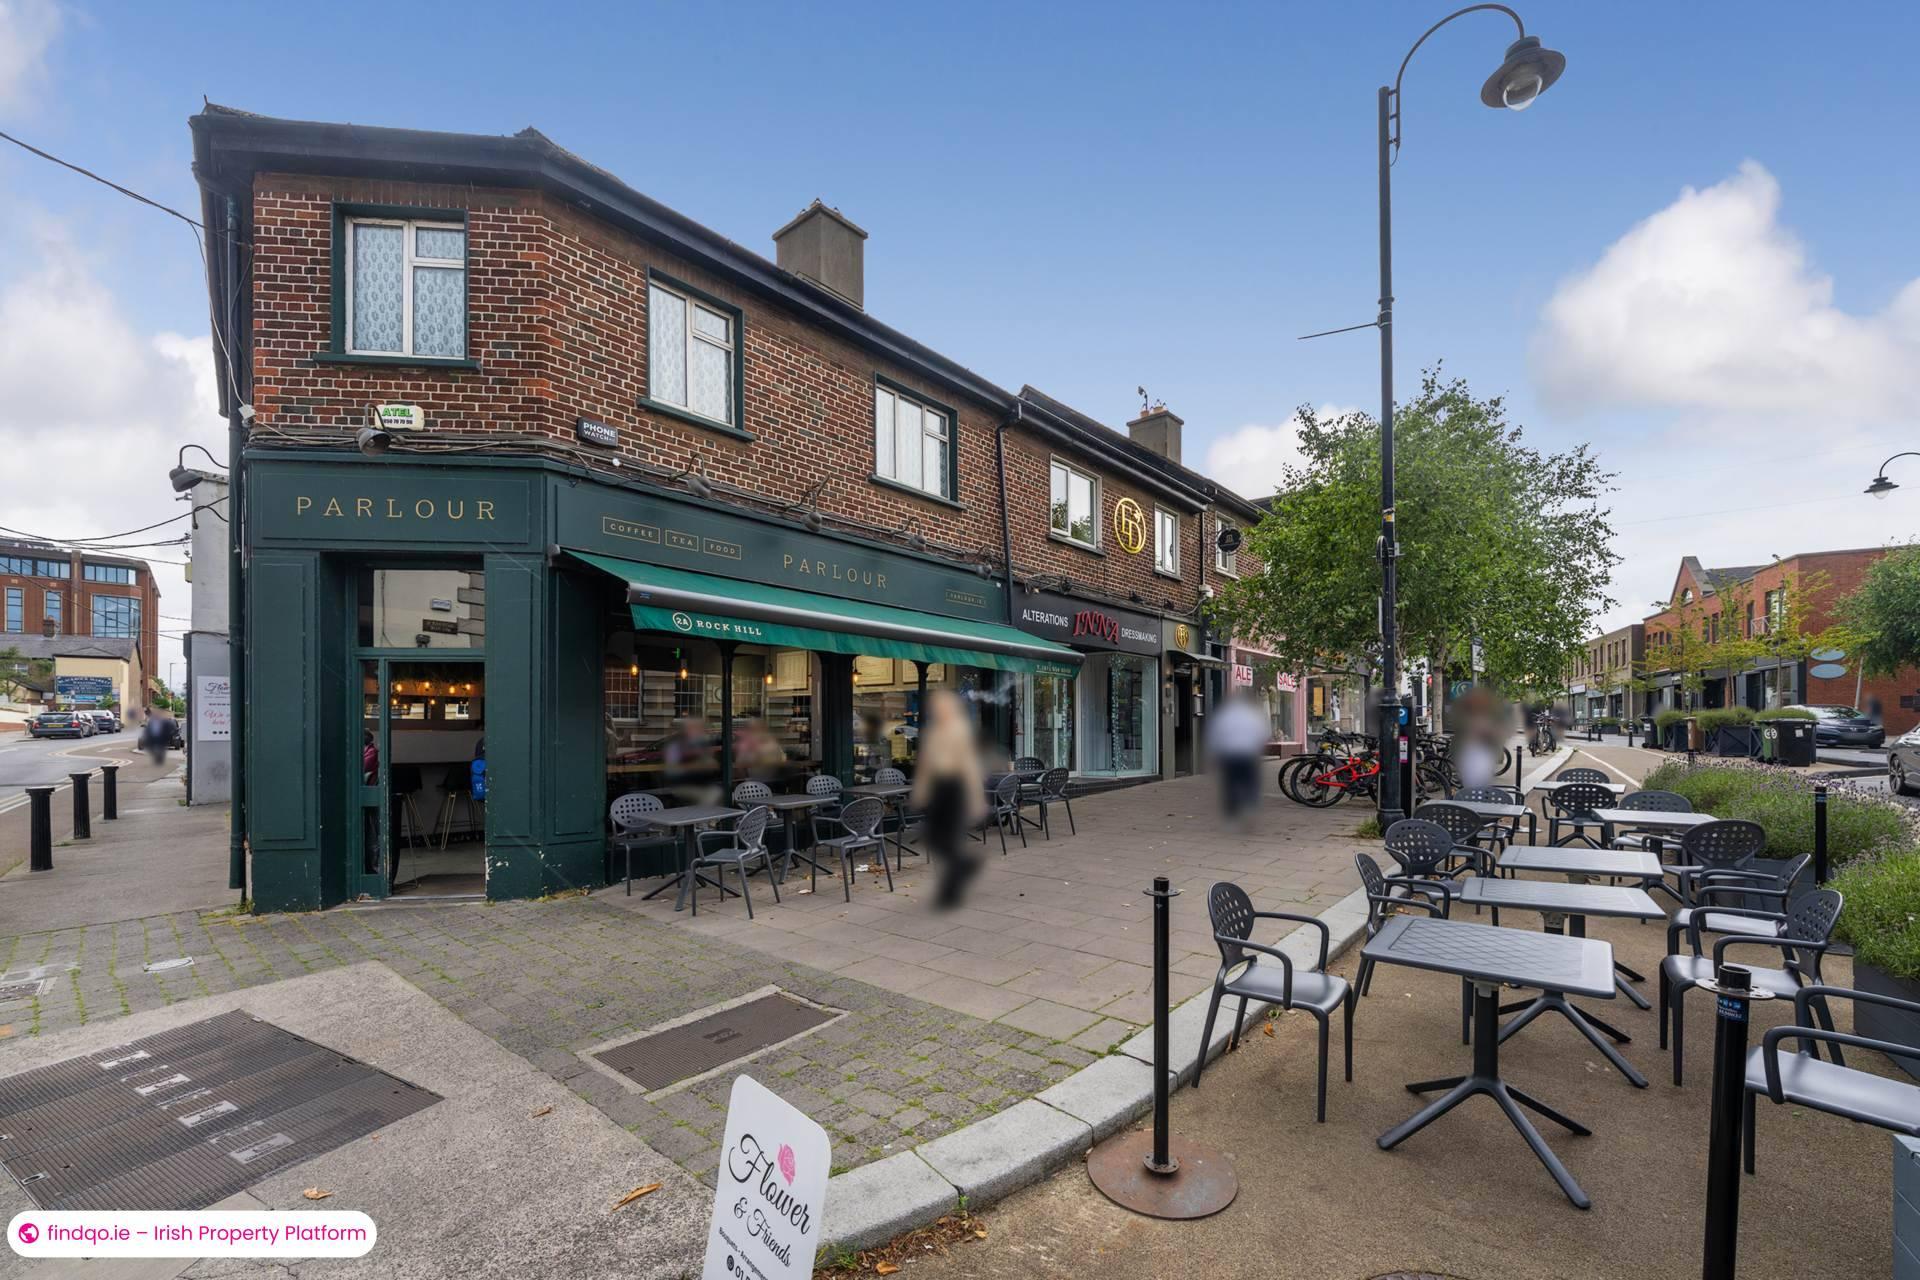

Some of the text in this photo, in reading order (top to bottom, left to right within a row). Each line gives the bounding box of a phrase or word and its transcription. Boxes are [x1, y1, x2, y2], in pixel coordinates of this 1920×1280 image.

[382, 407, 413, 417] ATEL
[583, 422, 616, 438] PHONE
[583, 430, 609, 441] WATCH
[296, 496, 497, 521] PARLOUR
[609, 522, 736, 555] COFFEE TEA FOOD
[782, 552, 889, 590] PARLOUR
[696, 620, 731, 632] ROCK
[734, 625, 762, 636] HILL
[1022, 608, 1069, 628] ALTERATIONS
[1072, 610, 1120, 645] INNA
[1121, 627, 1157, 644] DRESSMAKING
[1278, 671, 1296, 688] SALE
[728, 1133, 812, 1236] Flower
[733, 1196, 792, 1268] & Friends
